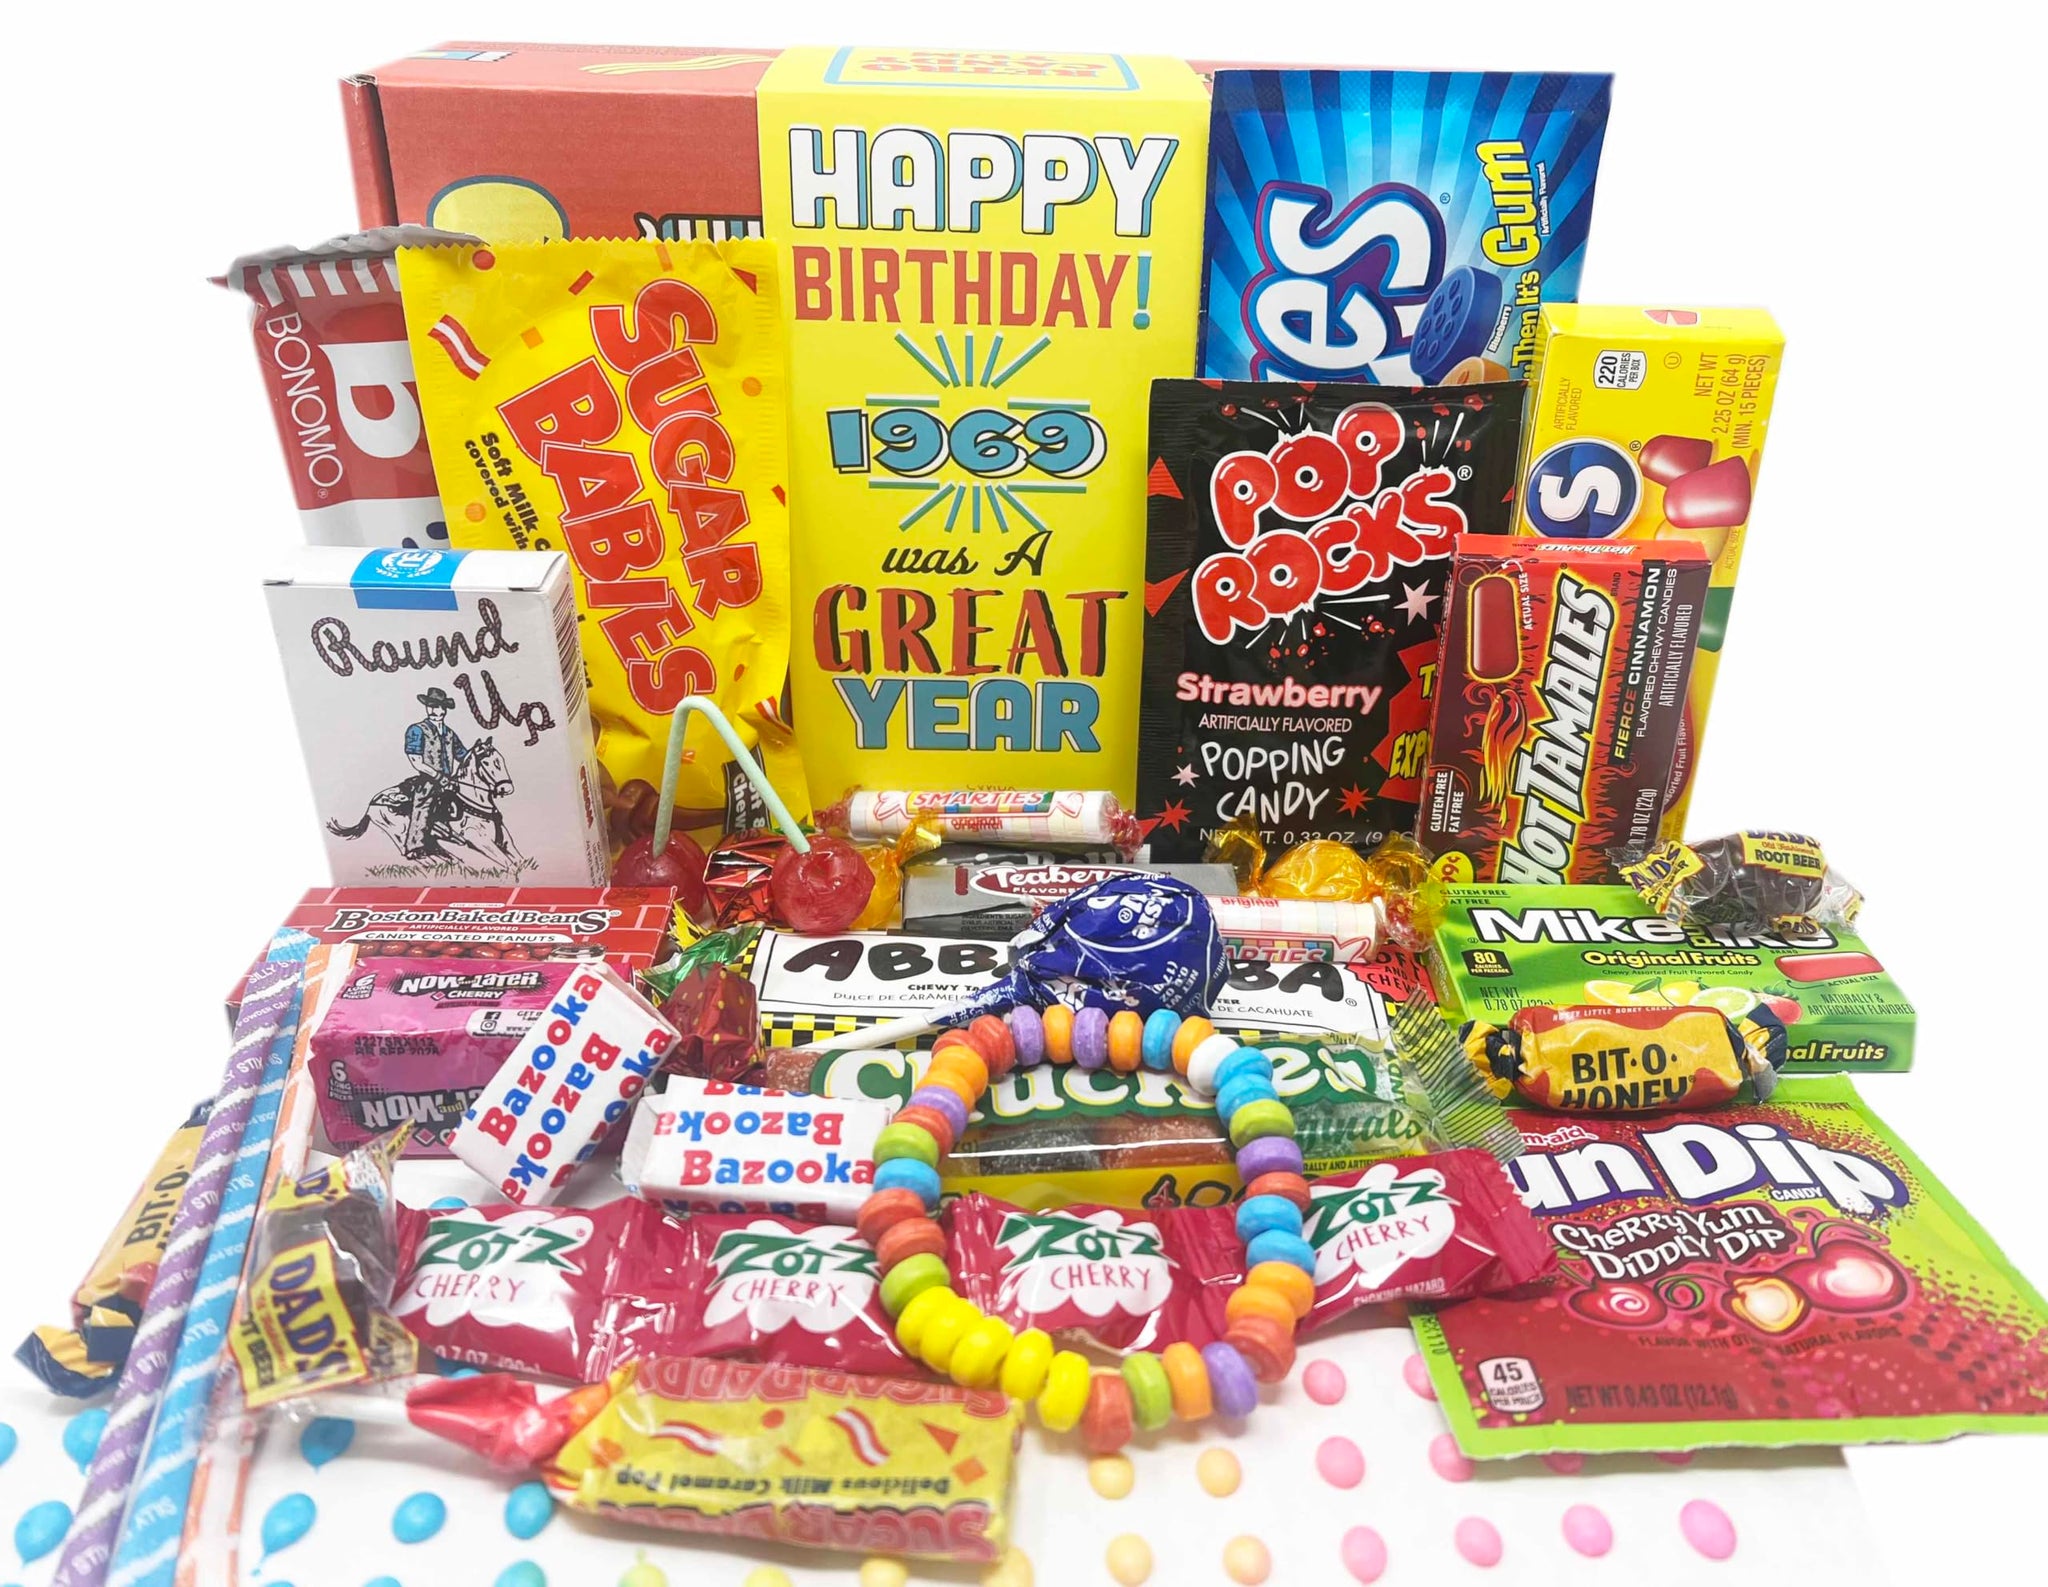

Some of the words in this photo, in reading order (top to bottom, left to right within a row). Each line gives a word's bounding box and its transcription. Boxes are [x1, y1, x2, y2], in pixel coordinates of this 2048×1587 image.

[789, 128, 1179, 237] HAPPY
[1476, 140, 1542, 267] Gum
[792, 246, 1152, 330] BIRTHDAY!
[1516, 270, 1541, 306] It's
[1488, 305, 1512, 352] Blueberry
[1598, 356, 1618, 384] 220
[1617, 352, 1631, 389] CALORIES
[1631, 358, 1641, 371] BOX
[1698, 352, 1718, 371] WT
[1725, 354, 1747, 365] g)
[1629, 372, 1640, 383] PER
[1694, 374, 1715, 397] NET
[1720, 368, 1742, 387] (64
[1741, 355, 1771, 398] PIECES)
[266, 312, 343, 487] BONOMO
[1554, 378, 1571, 430] ARTIFICIALLY
[1566, 388, 1582, 431] FLAVORED
[1716, 391, 1736, 405] OZ
[1738, 402, 1756, 416] 15
[1711, 409, 1732, 434] 2.25
[1731, 420, 1752, 448] (MIN.
[589, 279, 763, 619] SUGAR
[826, 408, 1107, 480] 1969
[464, 440, 505, 509] covered
[481, 431, 513, 478] Soft
[505, 482, 538, 533] Milk
[1210, 402, 1405, 550] POP
[495, 355, 717, 715] BABIES
[881, 545, 979, 576] was
[994, 530, 1054, 577] A
[1191, 465, 1468, 645] ROCKS
[1519, 572, 1531, 597] SIZE
[1521, 600, 1533, 631] ACTUAL
[311, 598, 519, 676] Round
[813, 584, 1128, 678] GREAT
[1614, 689, 1637, 759] FIERCE
[1628, 567, 1661, 686] CINNAMON
[1636, 673, 1657, 738] FLAVORED
[1649, 626, 1666, 673] CHEWY
[1658, 568, 1678, 625] CANDIES
[1658, 646, 1685, 707] ARTIFICIALLY
[1677, 604, 1693, 647] FLAVORED
[1175, 672, 1382, 715] Strawberry
[454, 670, 555, 747] Up
[832, 678, 1101, 752] YEAR
[1198, 713, 1281, 732] ARTIFICIALLY
[1281, 716, 1352, 733] FLAVORED
[1201, 735, 1345, 783] POPPING
[1437, 772, 1448, 794] FREE
[912, 790, 1044, 806] SMARTIES
[1216, 781, 1329, 824] CANDY
[1452, 790, 1464, 811] FREE
[1635, 789, 1658, 810] (22g)
[1430, 795, 1448, 831] GLUTEN
[1449, 812, 1460, 833] FAT
[1632, 813, 1651, 824] OZ
[1328, 831, 1358, 844] OZ.
[1755, 849, 1790, 866] ROOT
[1793, 852, 1822, 870] BEER
[328, 909, 442, 932] Boston
[445, 910, 517, 923] Baked
[1468, 908, 1686, 944] Mike
[365, 933, 420, 941] CANDY
[488, 934, 556, 942] PEANUTS
[1473, 952, 1497, 964] 80
[1582, 950, 1692, 969] Original
[1691, 950, 1762, 968] Fruits
[399, 975, 459, 993] NOW
[1602, 969, 1630, 977] Chewy
[1727, 969, 1754, 977] Candy
[1828, 977, 1859, 988] ACTUAL
[1860, 975, 1881, 984] SIZE
[447, 990, 504, 999] CHERRY
[833, 992, 874, 1000] DULCE
[878, 993, 895, 1001] DE
[1480, 987, 1500, 998] NET
[1501, 987, 1524, 999] WT.
[1483, 999, 1509, 1011] 0.78
[1820, 993, 1874, 1004] NATURALLY
[1876, 993, 1885, 1004] &
[1217, 1005, 1235, 1013] DE
[1238, 1006, 1314, 1018] CACAHUATE
[1584, 1007, 1612, 1017] LITTLE
[1616, 1006, 1642, 1014] HONEY
[1808, 1004, 1867, 1016] ARTIFICIALLY
[1867, 1003, 1915, 1016] FLAVORED
[478, 974, 603, 1146] Bazooka
[1821, 1043, 1887, 1061] Fruits
[331, 1060, 348, 1082] 6
[502, 1033, 622, 1205] Bazooka
[653, 1110, 845, 1146] Bazooka
[680, 1149, 874, 1187] Bazooka
[1330, 1161, 1347, 1171] AND
[1640, 1123, 1903, 1217] Dip
[1771, 1187, 1823, 1201] CANDY
[1336, 1216, 1432, 1261] CHERRY
[416, 1273, 525, 1302] CHERRY
[1051, 1263, 1150, 1290] CHERRY
[1405, 1278, 1446, 1297] HAZARD
[733, 1277, 846, 1306] CHERRY
[1639, 1335, 1690, 1349] FLAVOR
[1492, 1362, 1523, 1384] 45
[1566, 1386, 1598, 1409] NET
[1599, 1386, 1622, 1408] WT
[1623, 1385, 1659, 1408] 0.43
[1660, 1384, 1682, 1407] OZ
[616, 1464, 663, 1491] Pop
[670, 1474, 771, 1496] Caramel
[781, 1476, 833, 1494] Milk
[842, 1476, 950, 1496] Delicious
